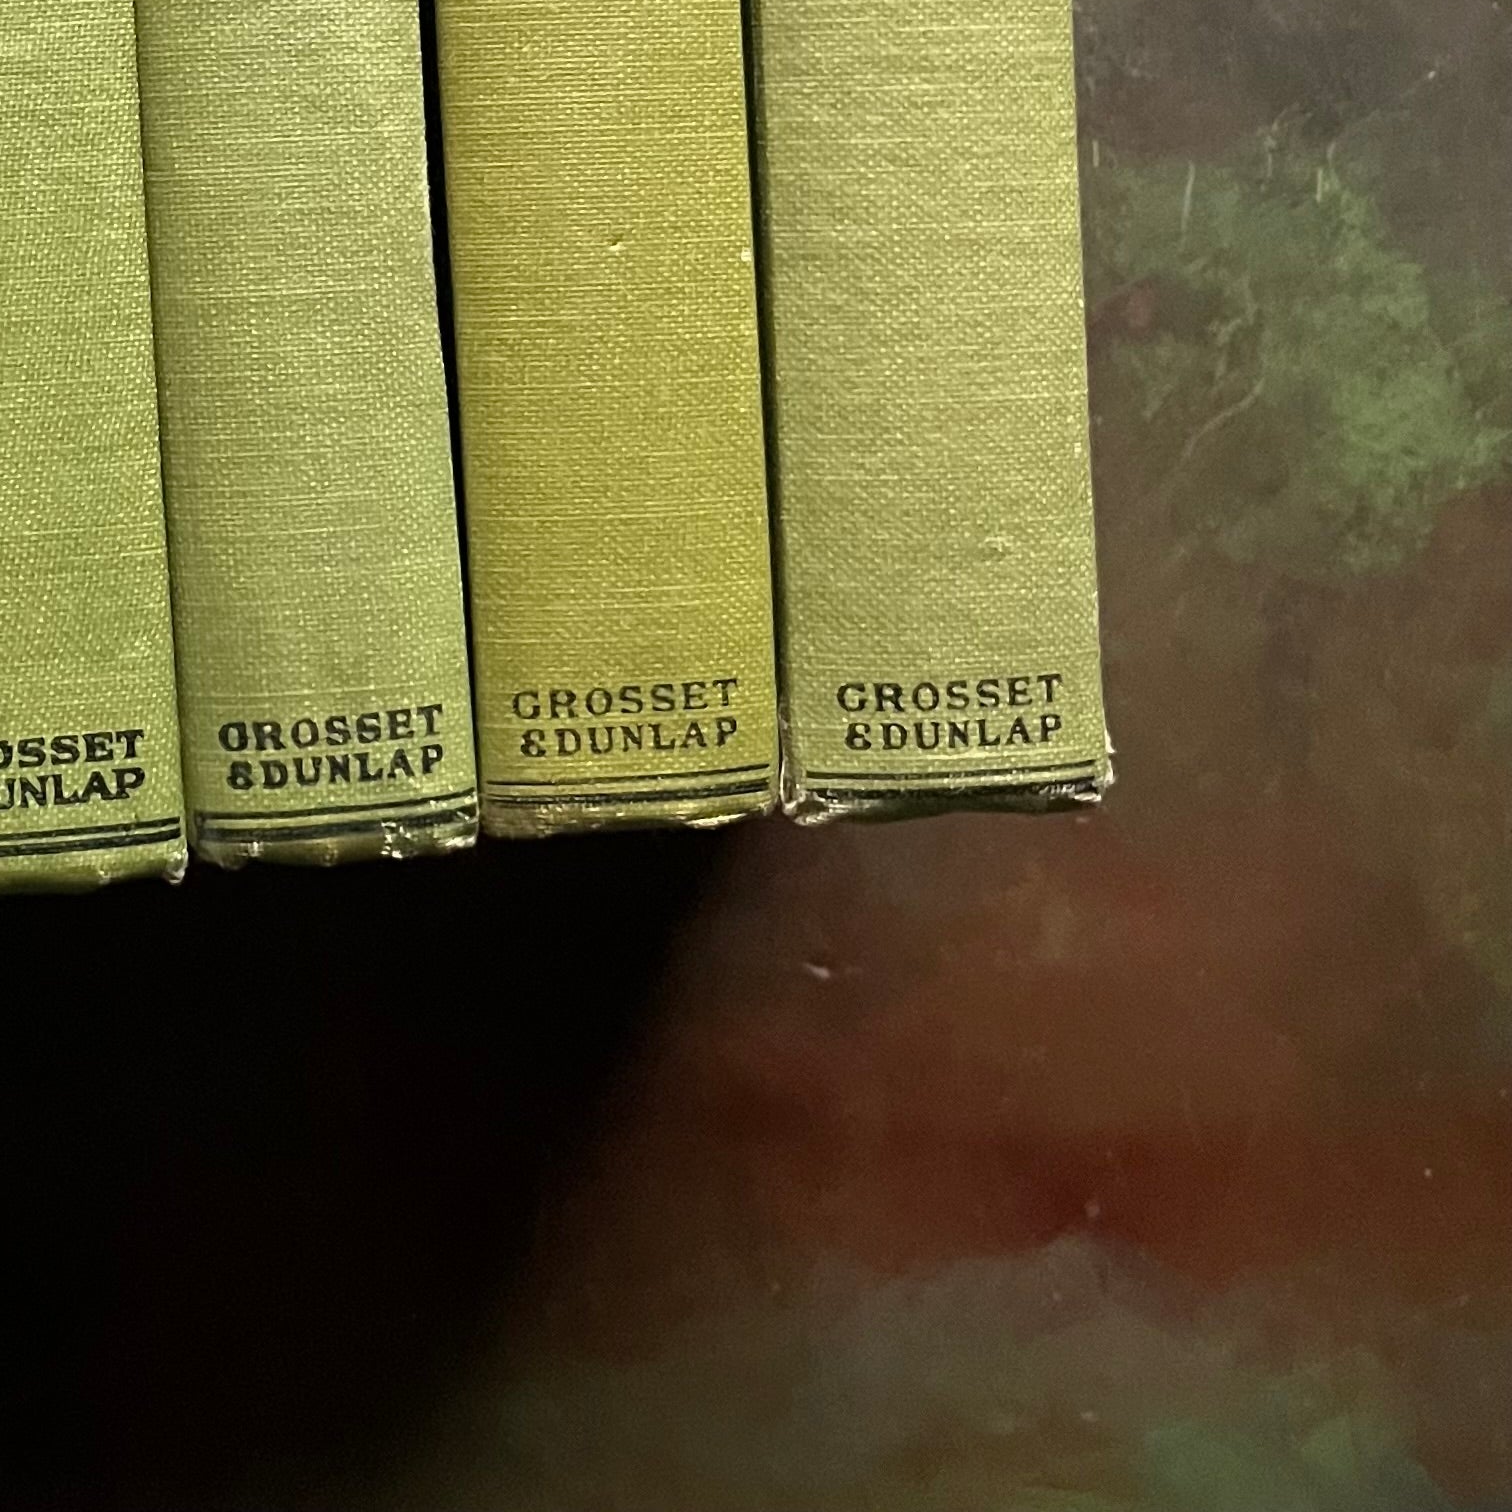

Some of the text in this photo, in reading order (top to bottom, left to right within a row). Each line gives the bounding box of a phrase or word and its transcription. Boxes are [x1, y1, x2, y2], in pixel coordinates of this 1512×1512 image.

[512, 678, 741, 723] GROSSET
[836, 673, 1065, 717] GROSSET
[218, 703, 444, 756] GROSSET
